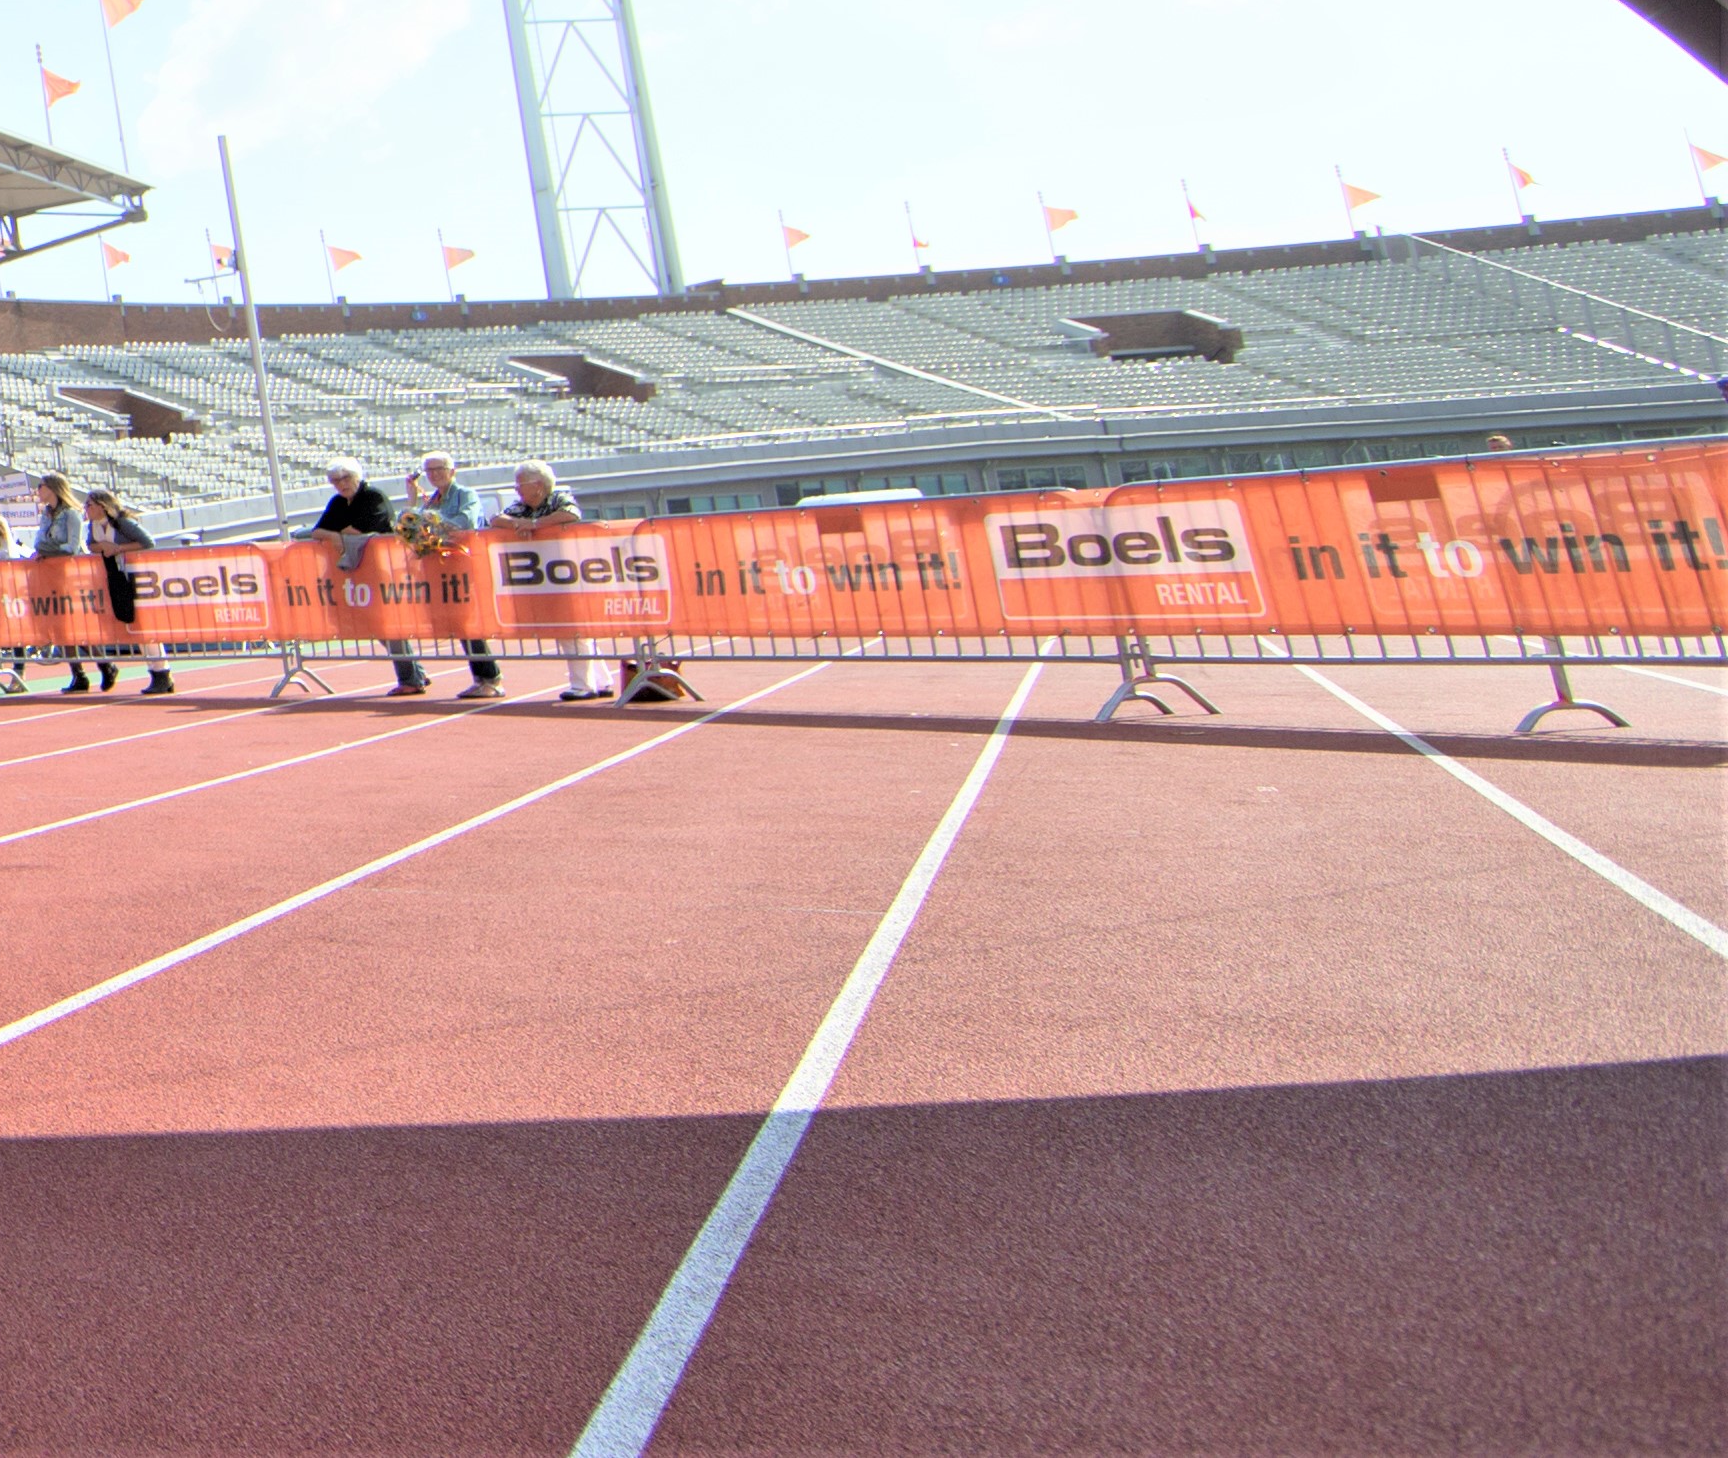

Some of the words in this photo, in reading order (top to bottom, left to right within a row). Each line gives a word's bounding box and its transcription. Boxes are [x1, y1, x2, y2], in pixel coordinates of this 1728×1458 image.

[999, 515, 1236, 569] Boels
[1289, 535, 1343, 581] in
[1357, 532, 1408, 579] it
[1416, 531, 1484, 578] to
[1499, 522, 1632, 575] win
[1647, 516, 1728, 572] it!
[128, 565, 259, 601] Boels
[497, 545, 660, 588] Boels
[694, 562, 726, 596] in
[739, 560, 766, 595] it
[775, 559, 815, 596] to
[827, 553, 904, 593] win
[916, 548, 962, 591] it!
[3, 593, 26, 618] to
[31, 590, 74, 616] win
[81, 588, 105, 615] it!
[286, 578, 312, 607] in
[317, 577, 337, 607] it
[342, 577, 371, 607] to
[379, 574, 430, 605] win
[441, 572, 470, 604] it!
[603, 597, 662, 617] RENTAL
[1155, 581, 1249, 606] RENTAL
[214, 606, 261, 623] RENTAL
